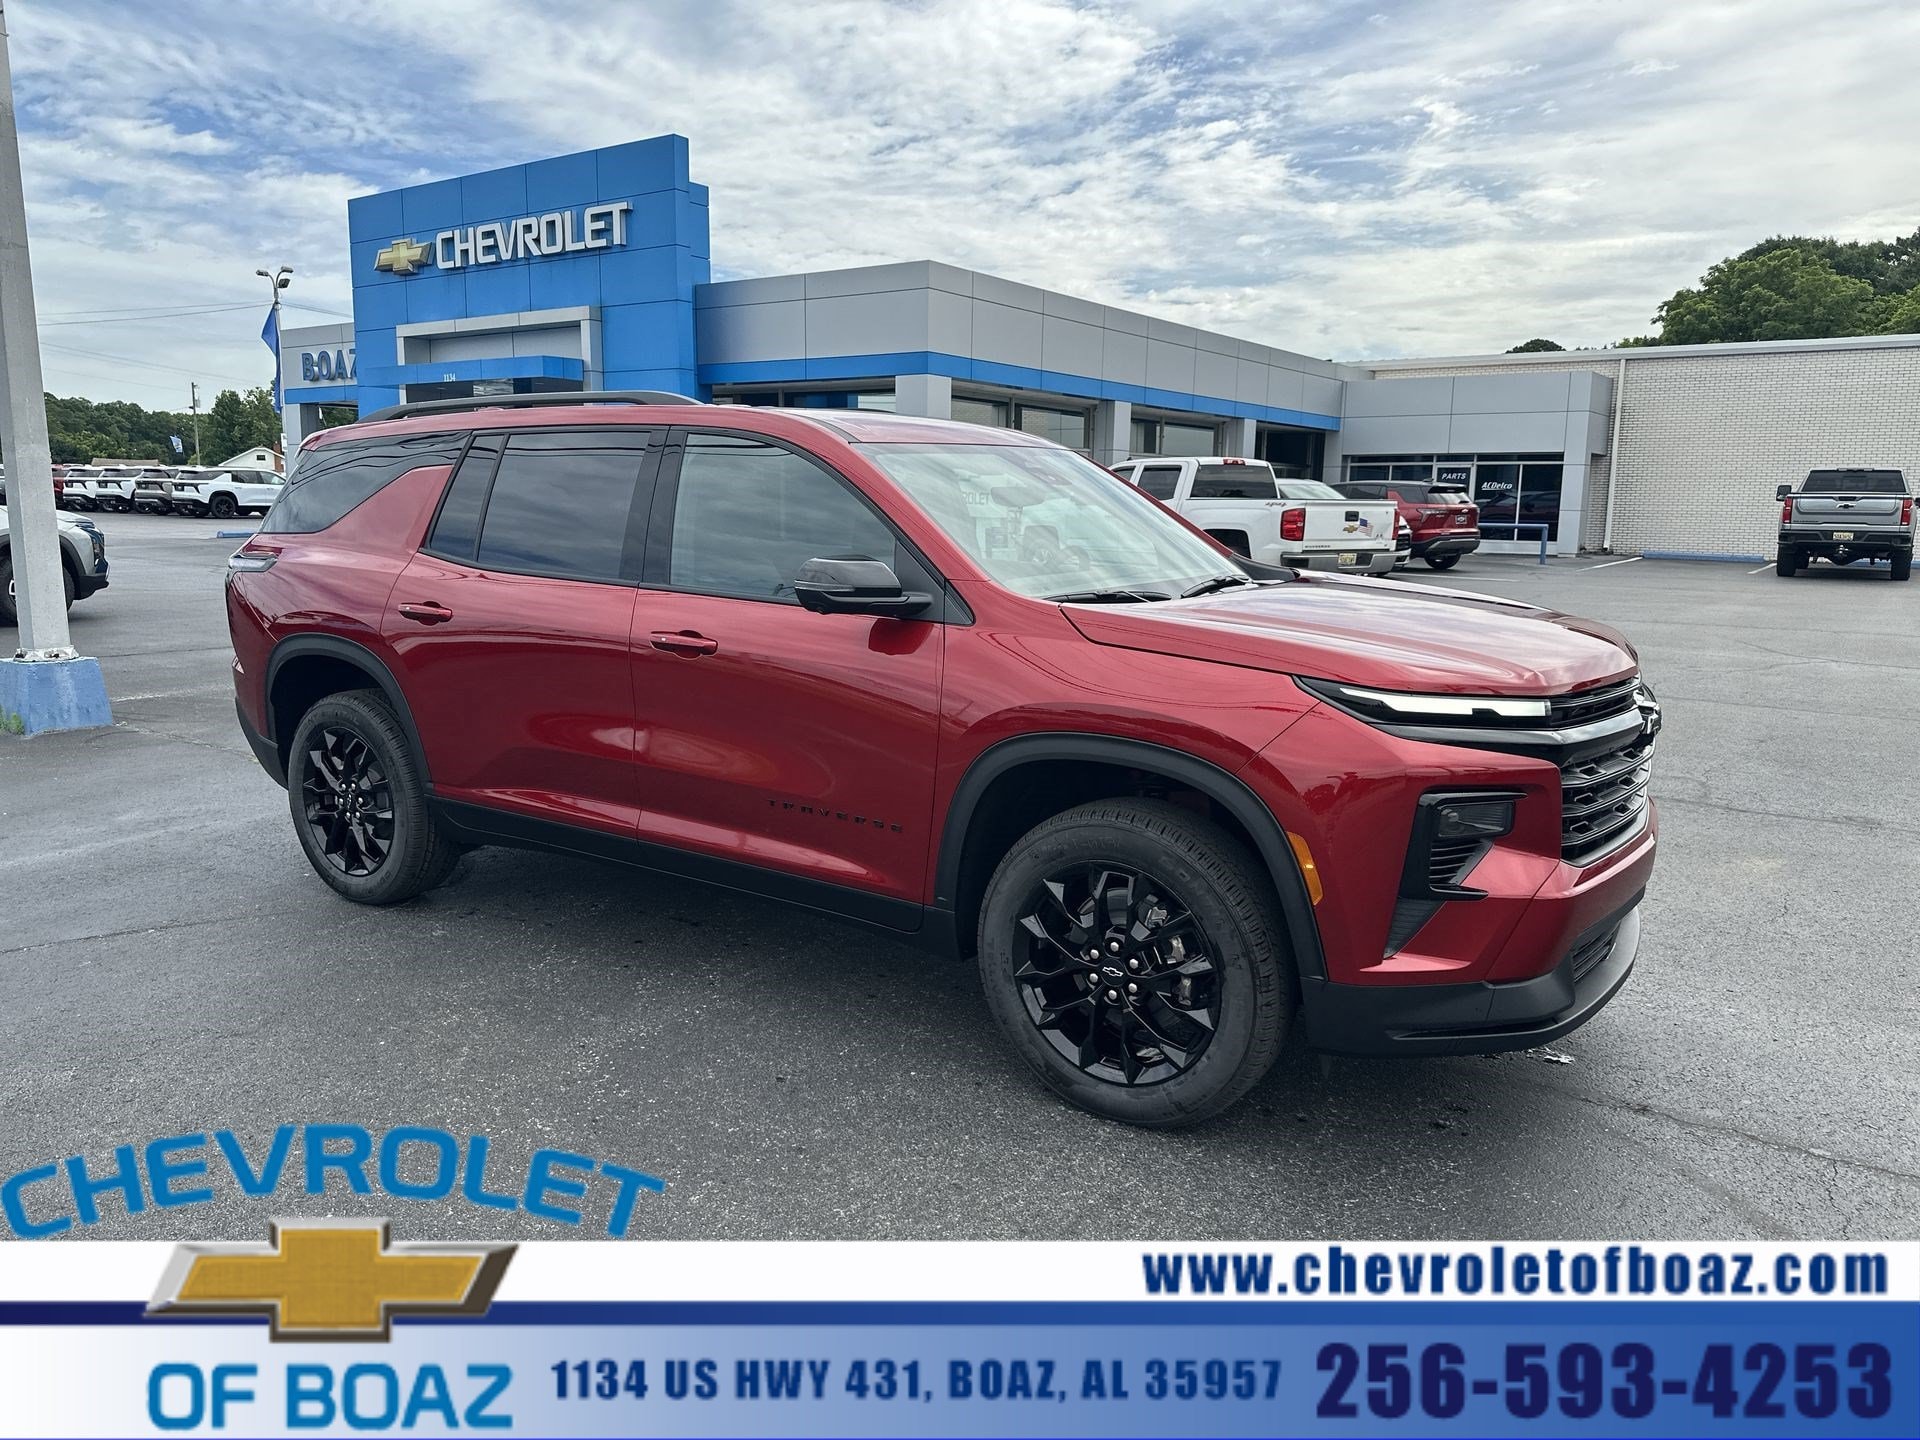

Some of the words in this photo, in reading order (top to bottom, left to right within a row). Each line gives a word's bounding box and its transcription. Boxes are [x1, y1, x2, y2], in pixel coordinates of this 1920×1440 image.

[436, 201, 633, 269] CHEVROLET
[1441, 472, 1467, 480] PARTS
[1481, 481, 1513, 491] ACDelco
[768, 799, 902, 833] TRAVERSE
